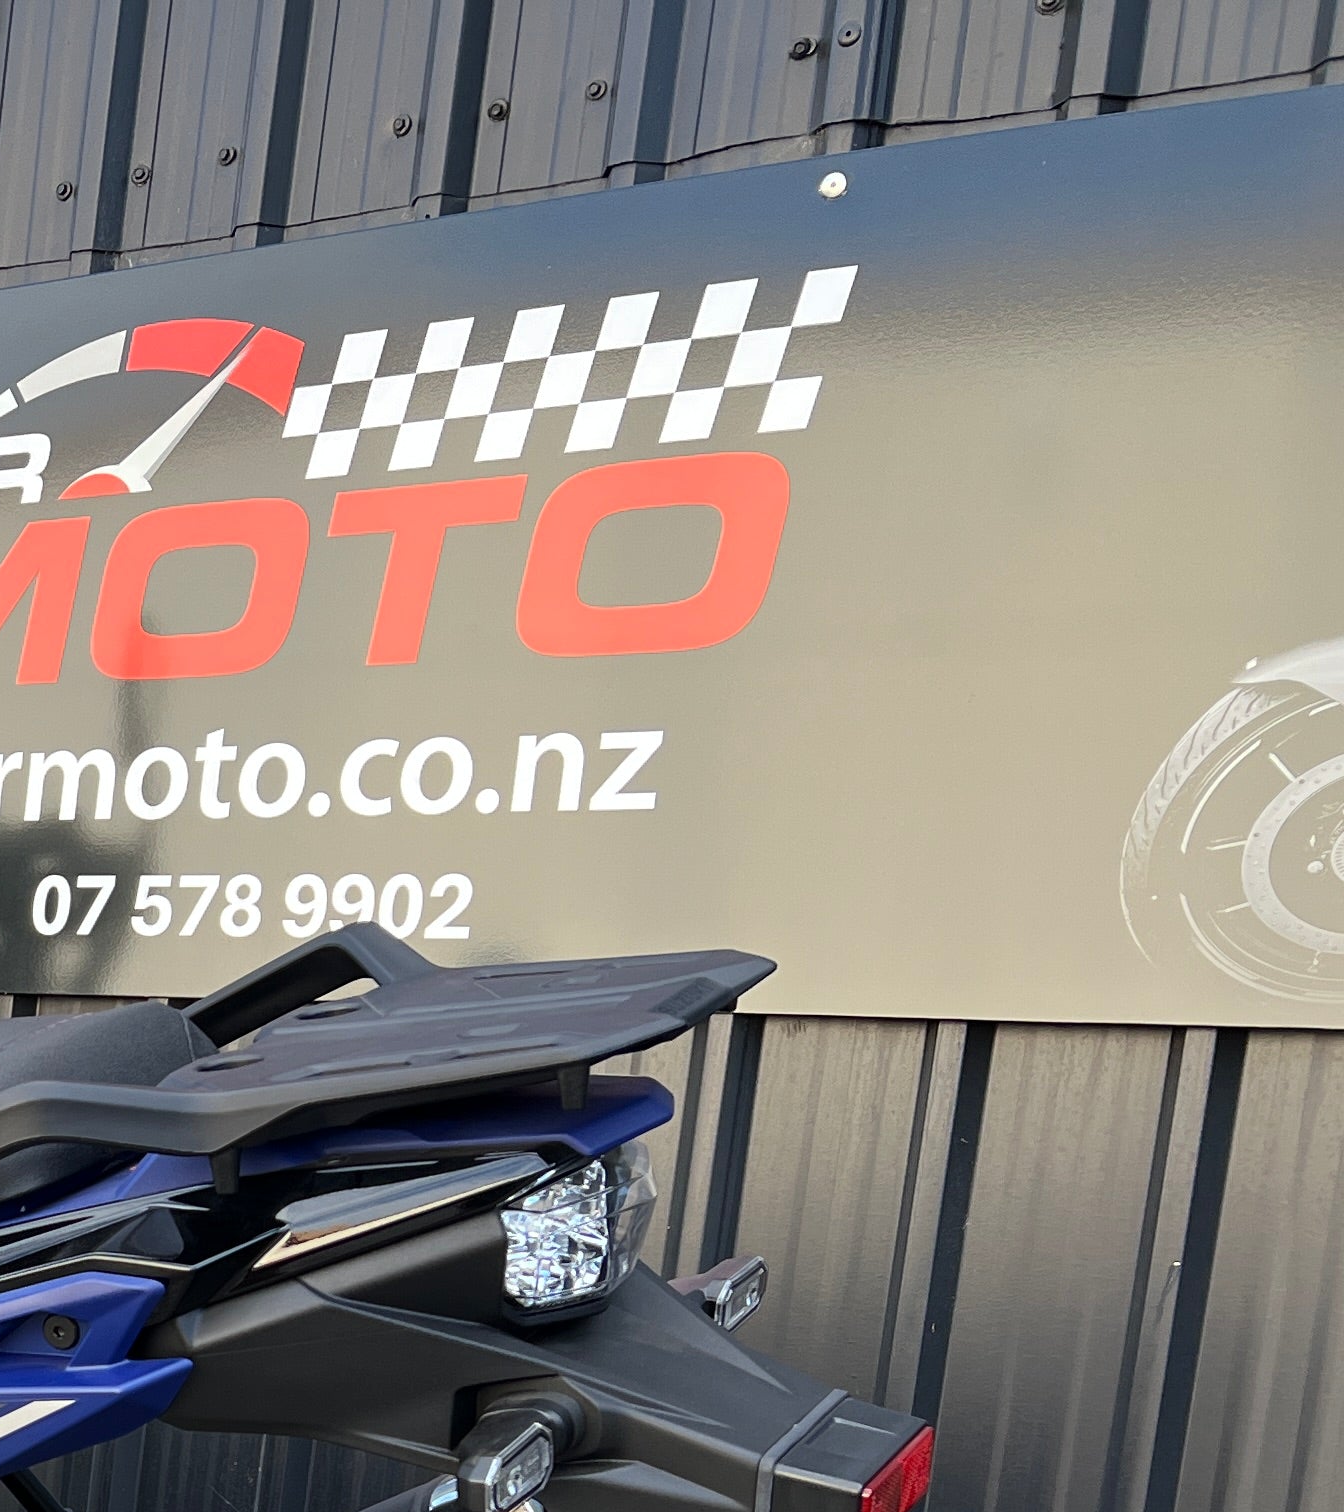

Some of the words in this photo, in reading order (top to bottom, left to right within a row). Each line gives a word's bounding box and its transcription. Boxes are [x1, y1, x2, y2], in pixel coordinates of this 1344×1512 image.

[31, 873, 116, 938] 07
[130, 872, 263, 938] 578
[282, 872, 474, 940] 9902
